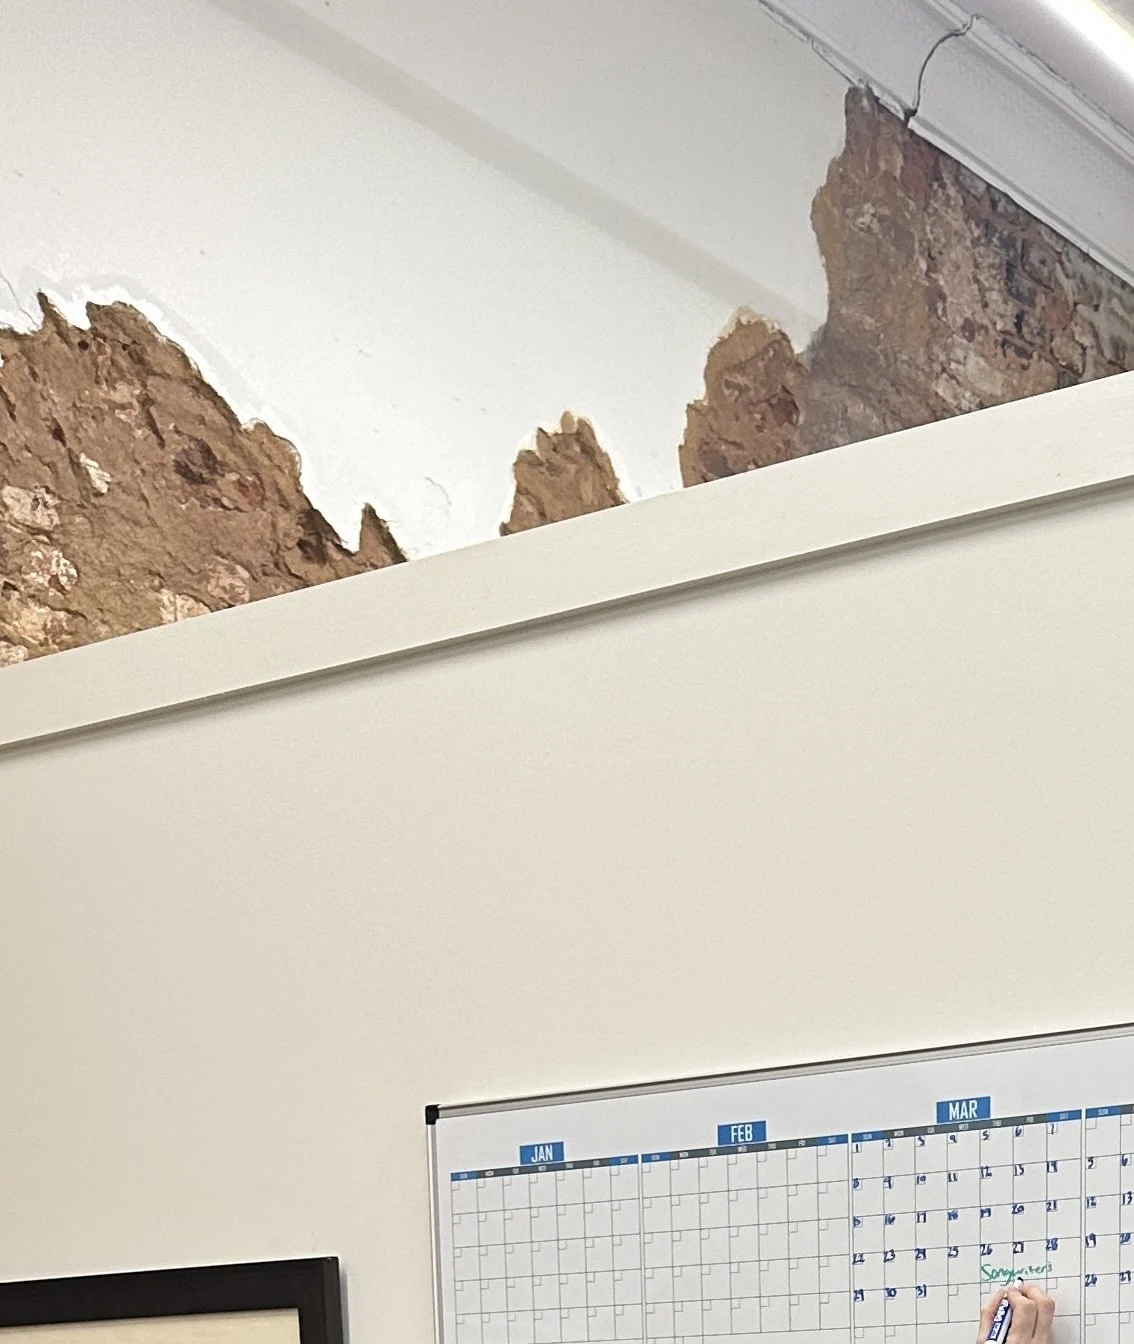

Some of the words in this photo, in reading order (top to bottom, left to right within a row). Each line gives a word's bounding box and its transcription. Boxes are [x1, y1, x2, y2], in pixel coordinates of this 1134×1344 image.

[949, 1100, 977, 1120] MAR
[731, 1124, 753, 1143] FEB
[983, 1130, 989, 1140] 5
[1015, 1126, 1021, 1137] 6
[531, 1145, 553, 1163] JAN
[1121, 1154, 1128, 1166] 6
[917, 1175, 926, 1184] 10
[981, 1166, 992, 1178] 12
[1122, 1191, 1132, 1205] 13
[885, 1214, 895, 1225] 16
[1012, 1203, 1024, 1214] 20
[1046, 1200, 1056, 1211] 21
[1085, 1233, 1096, 1247] 19
[884, 1250, 895, 1262] 23
[948, 1246, 958, 1257] 25
[980, 1244, 992, 1255] 26
[886, 1287, 897, 1297] 30
[916, 1284, 926, 1297] 31
